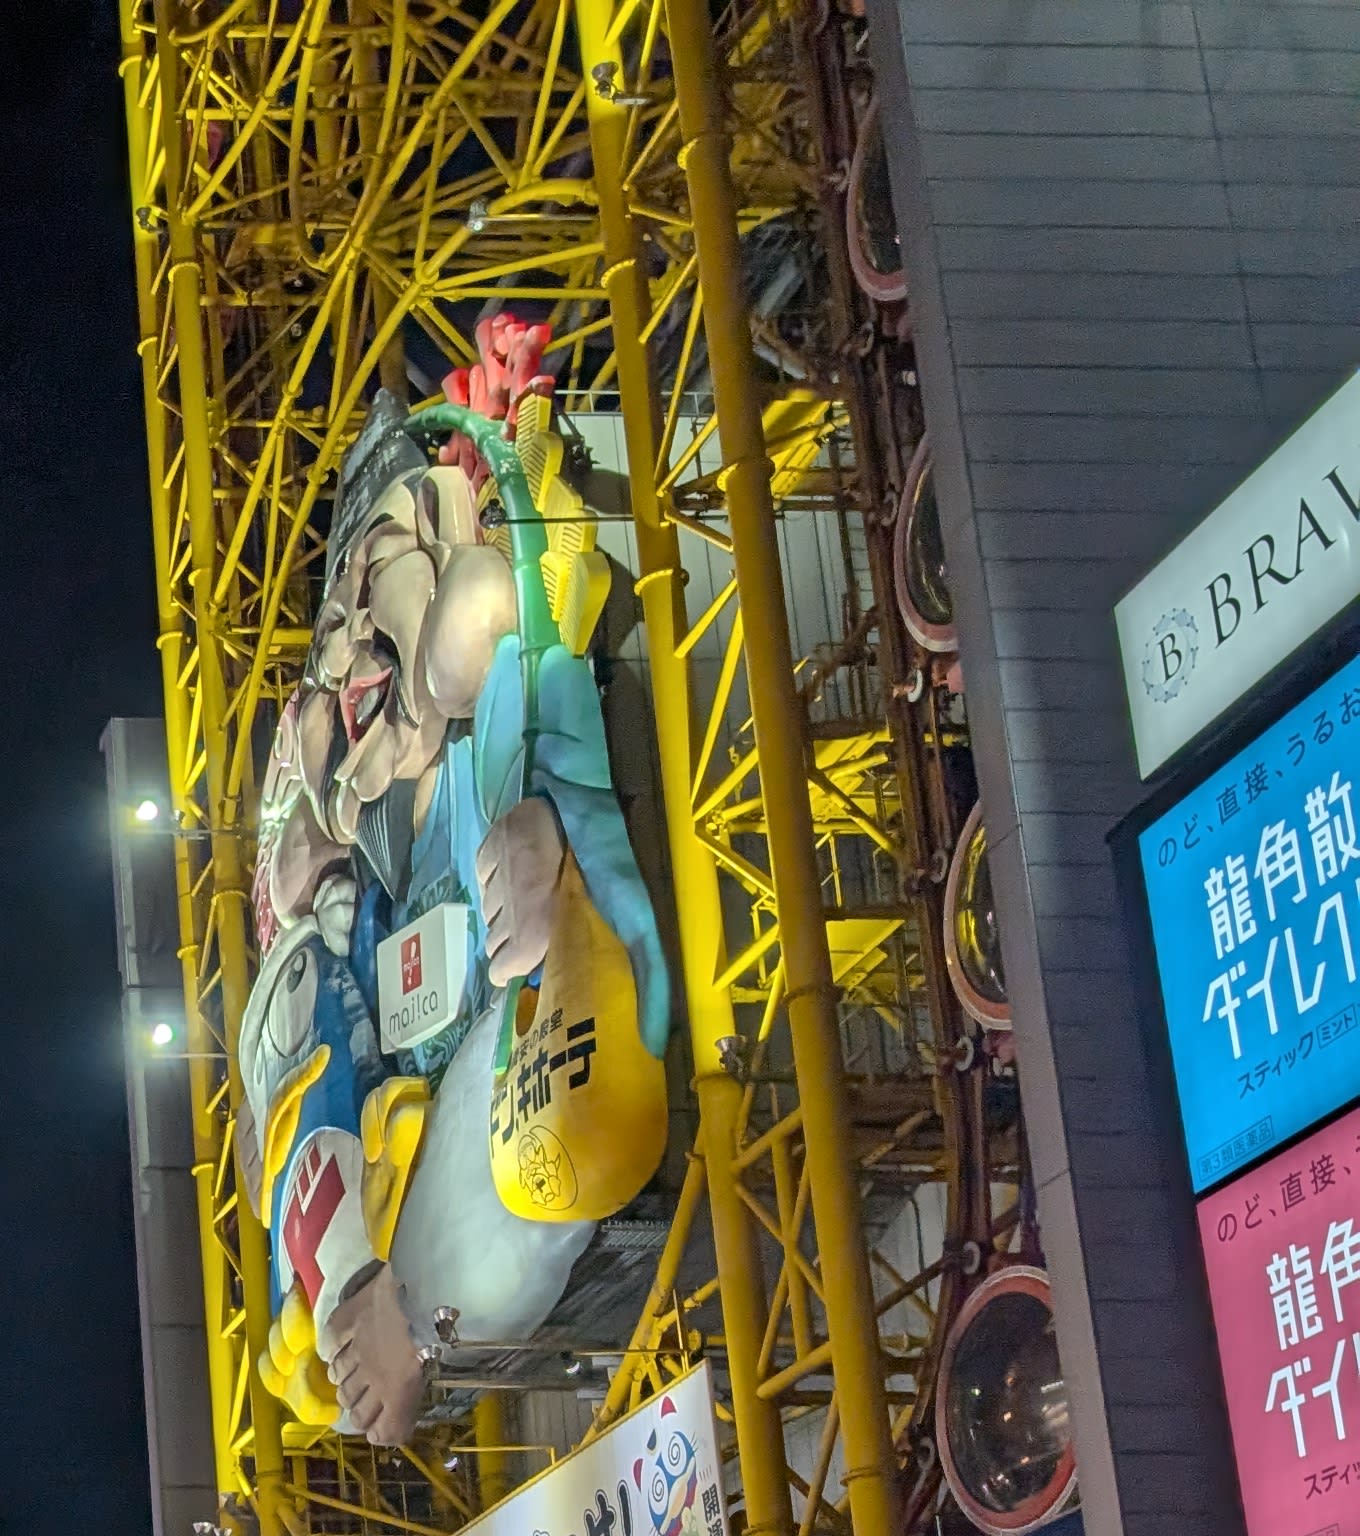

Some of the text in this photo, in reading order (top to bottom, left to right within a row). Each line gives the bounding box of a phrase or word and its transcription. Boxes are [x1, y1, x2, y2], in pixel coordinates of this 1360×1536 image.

[1203, 770, 1360, 960] 龍角散
[1202, 876, 1360, 1060] ダイレク
[1237, 1011, 1355, 1099] スティック ミント
[1217, 1135, 1360, 1243] のど、直接、
[1264, 1331, 1360, 1458] ダイ
